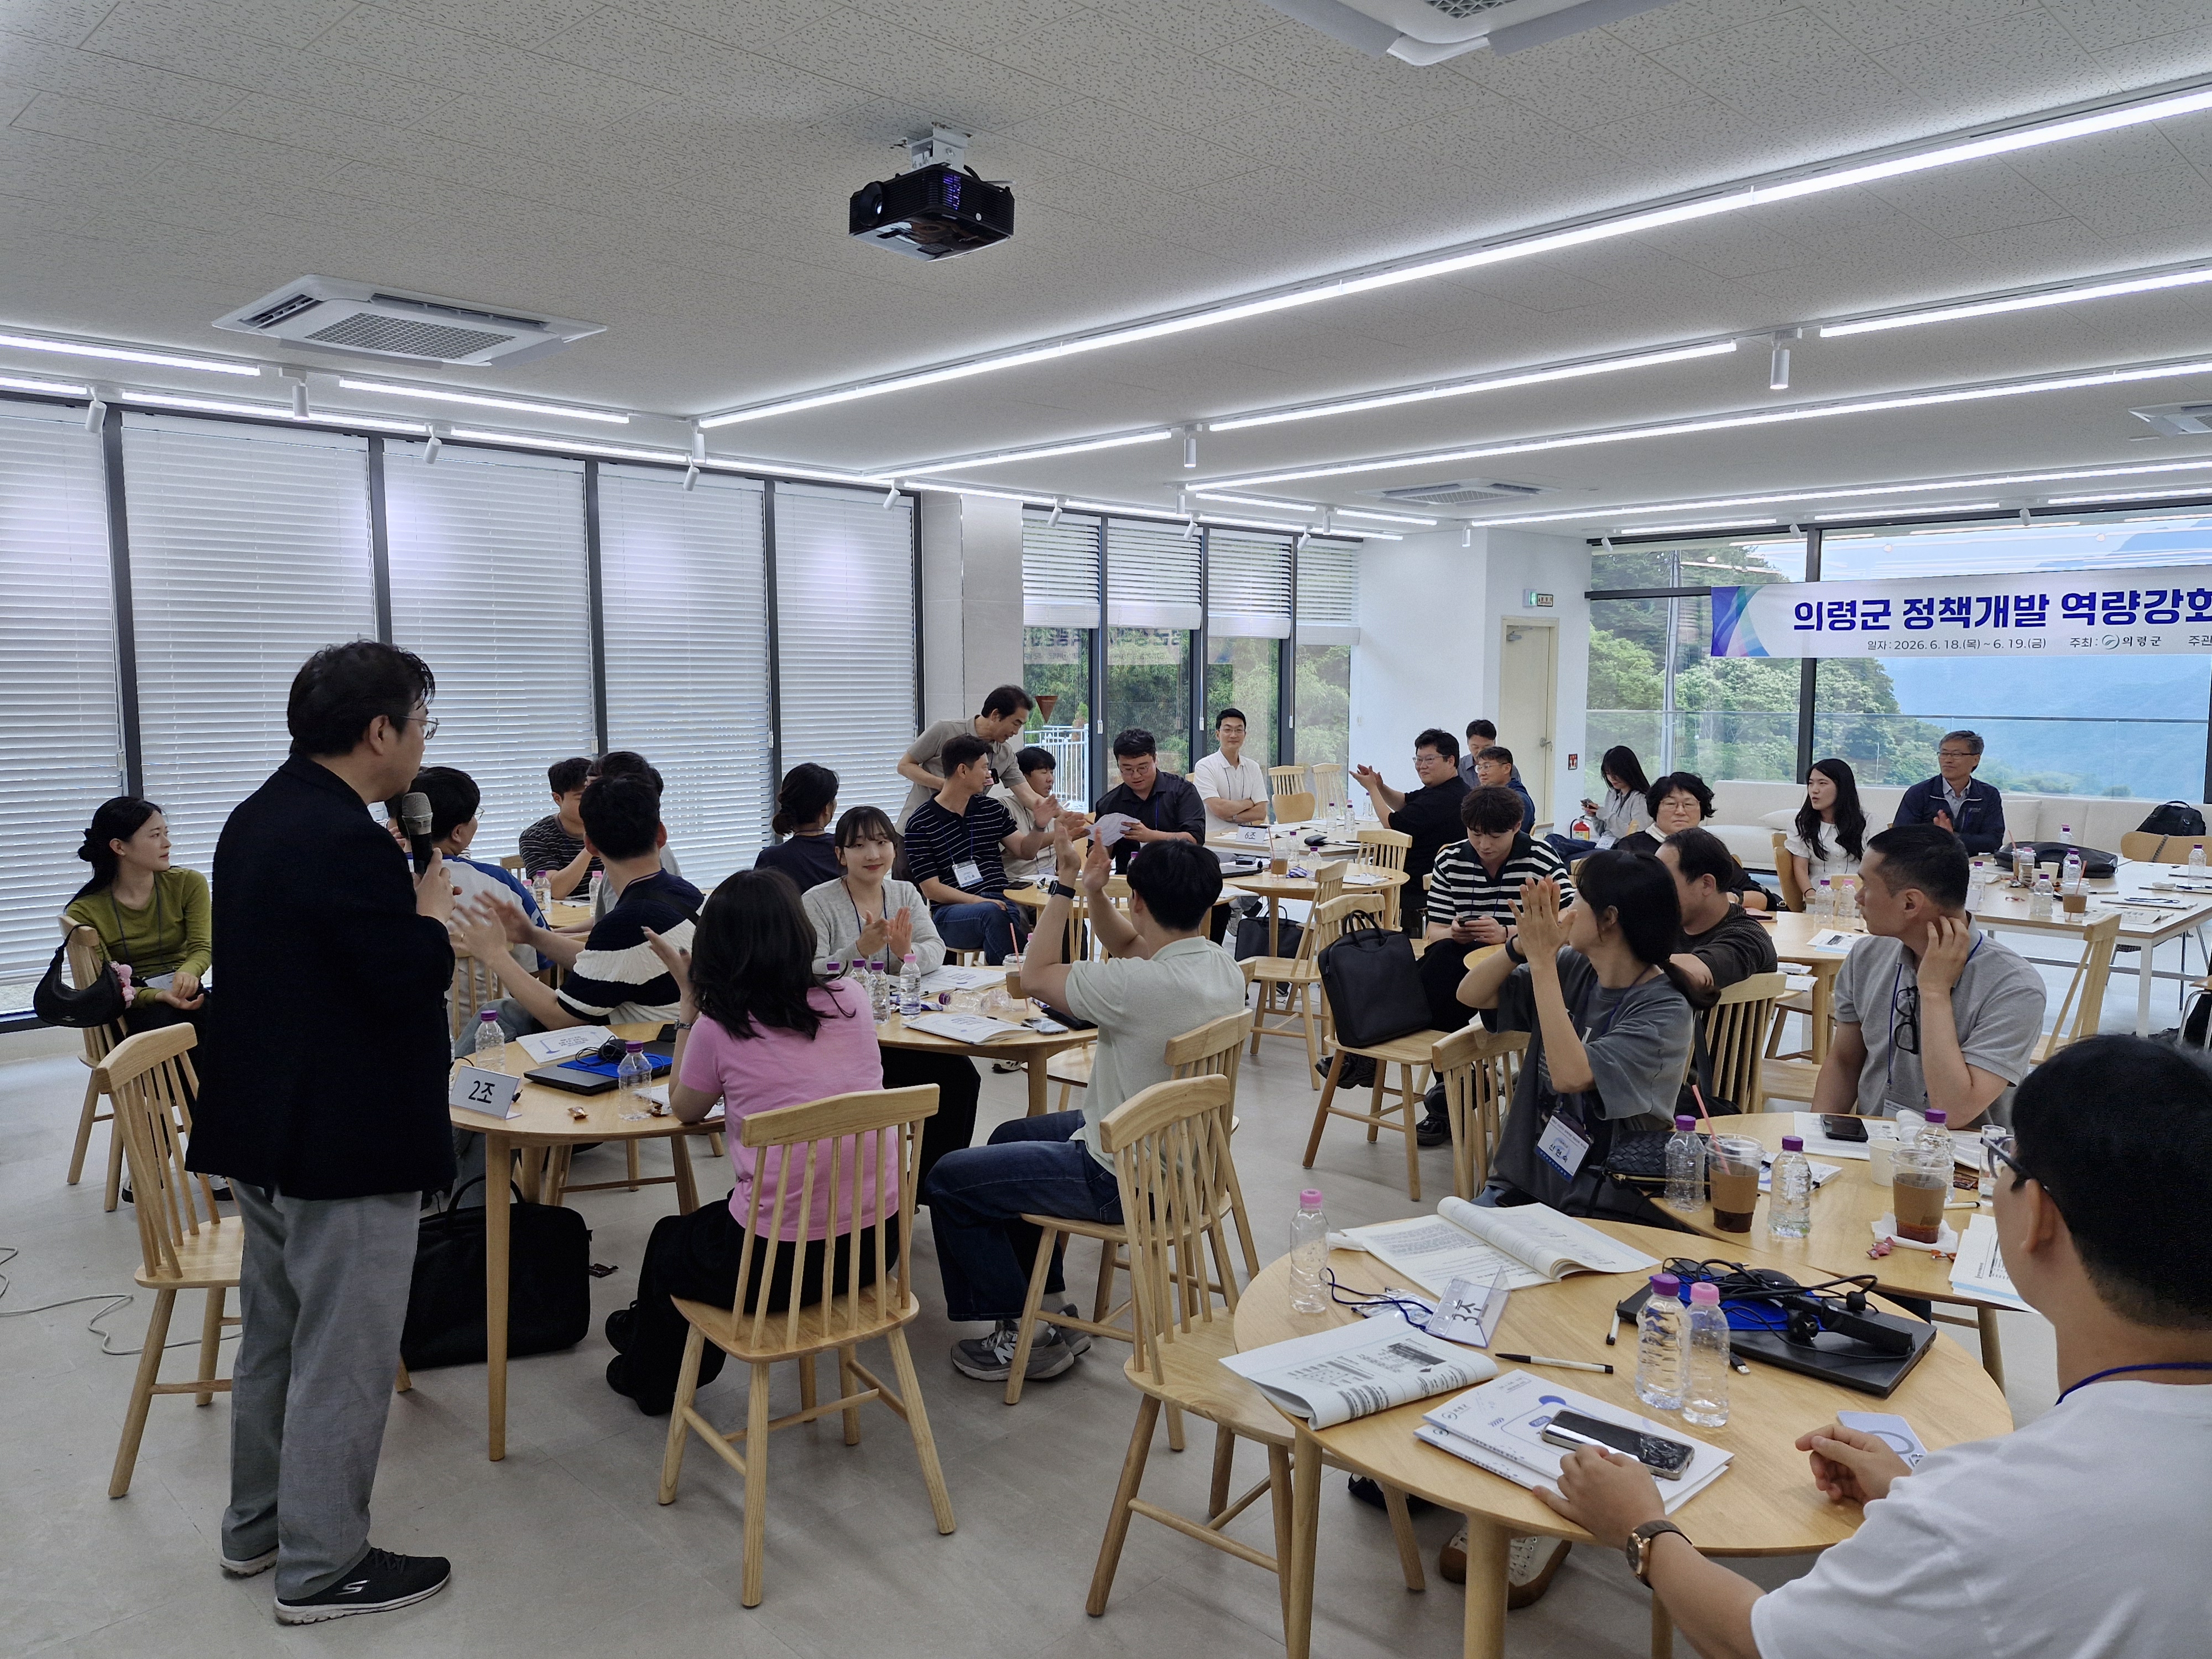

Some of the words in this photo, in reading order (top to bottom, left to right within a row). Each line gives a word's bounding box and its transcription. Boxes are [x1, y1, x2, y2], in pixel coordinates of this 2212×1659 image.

[1794, 599, 1891, 631] 의령군
[1902, 594, 2049, 629] 정책개발
[2122, 635, 2162, 647] 의령군
[468, 1080, 495, 1104] 2조
